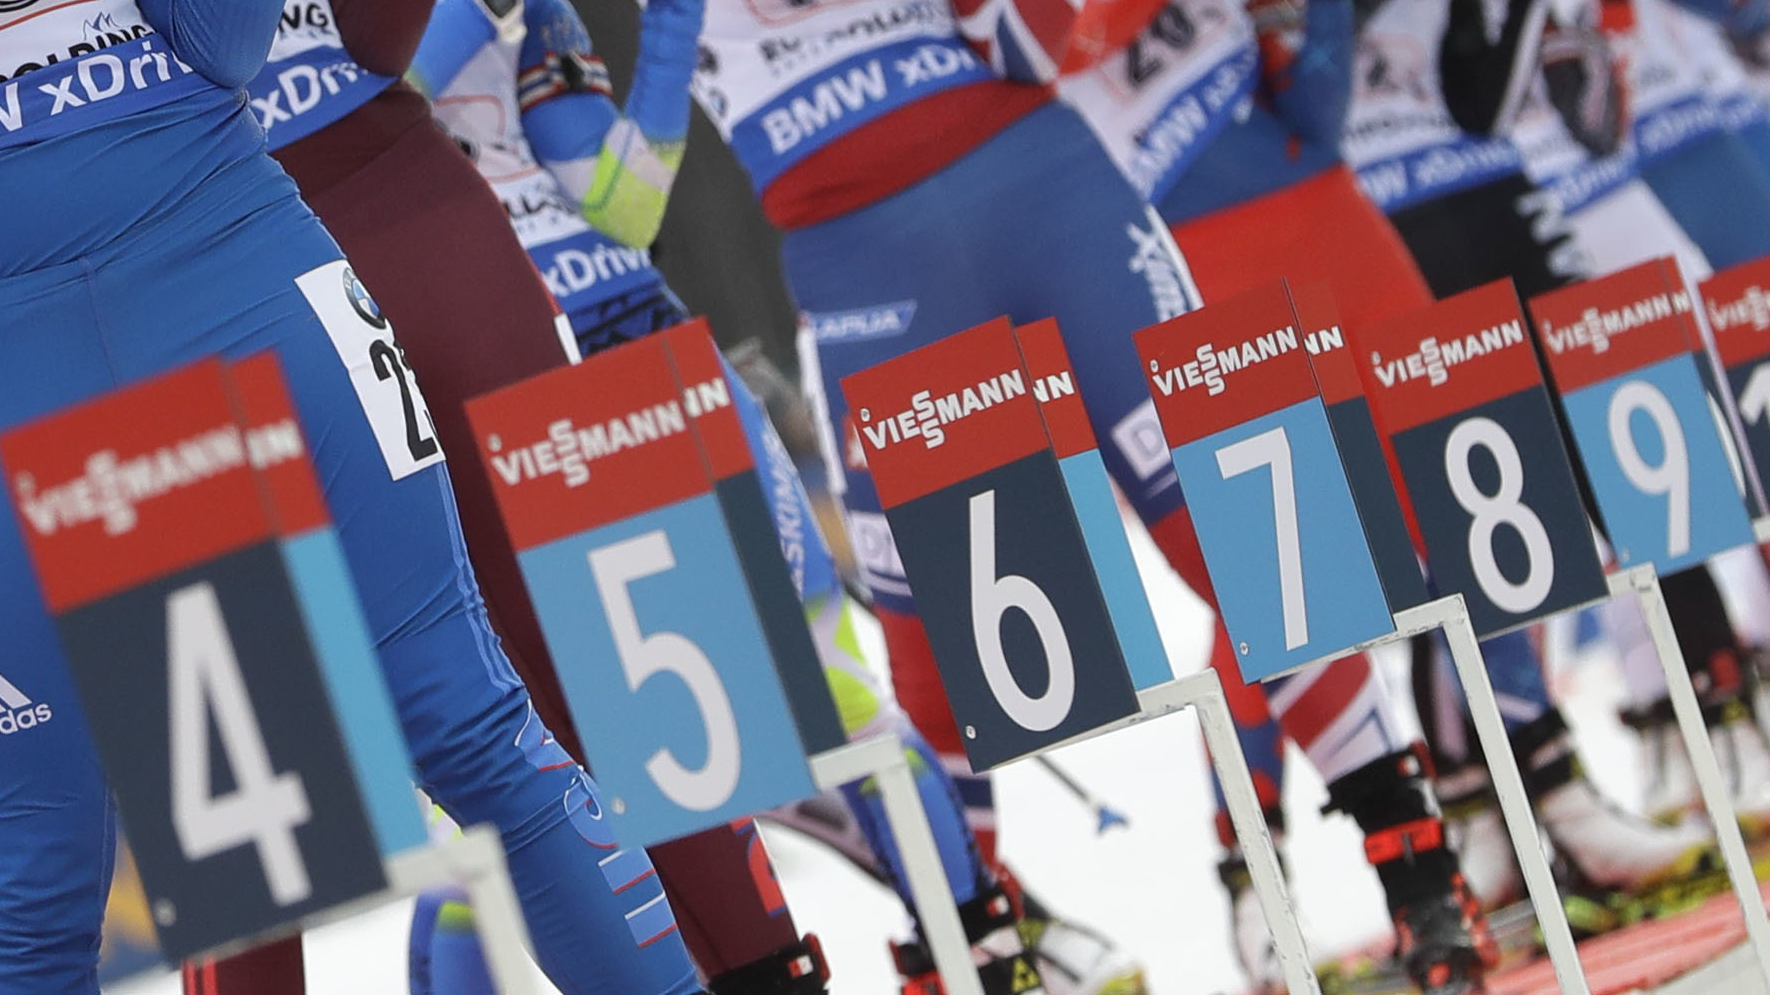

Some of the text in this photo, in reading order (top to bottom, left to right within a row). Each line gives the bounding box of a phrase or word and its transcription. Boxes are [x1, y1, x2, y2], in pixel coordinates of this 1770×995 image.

[761, 59, 887, 154] BMW
[1152, 325, 1299, 397] VIESSMANN
[1374, 318, 1524, 389] VIESSMANN
[1546, 292, 1672, 355] VIESSMANN
[369, 339, 439, 462] 2
[492, 400, 686, 489] VIESSMANN
[863, 369, 1026, 450] VIESSMANN
[19, 424, 245, 536] VIESSMANN
[1444, 415, 1555, 614] 8
[1607, 380, 1691, 559] 9
[1214, 425, 1309, 651] 7
[968, 489, 1076, 733] 6
[587, 529, 742, 812] 5
[165, 582, 313, 908] 4
